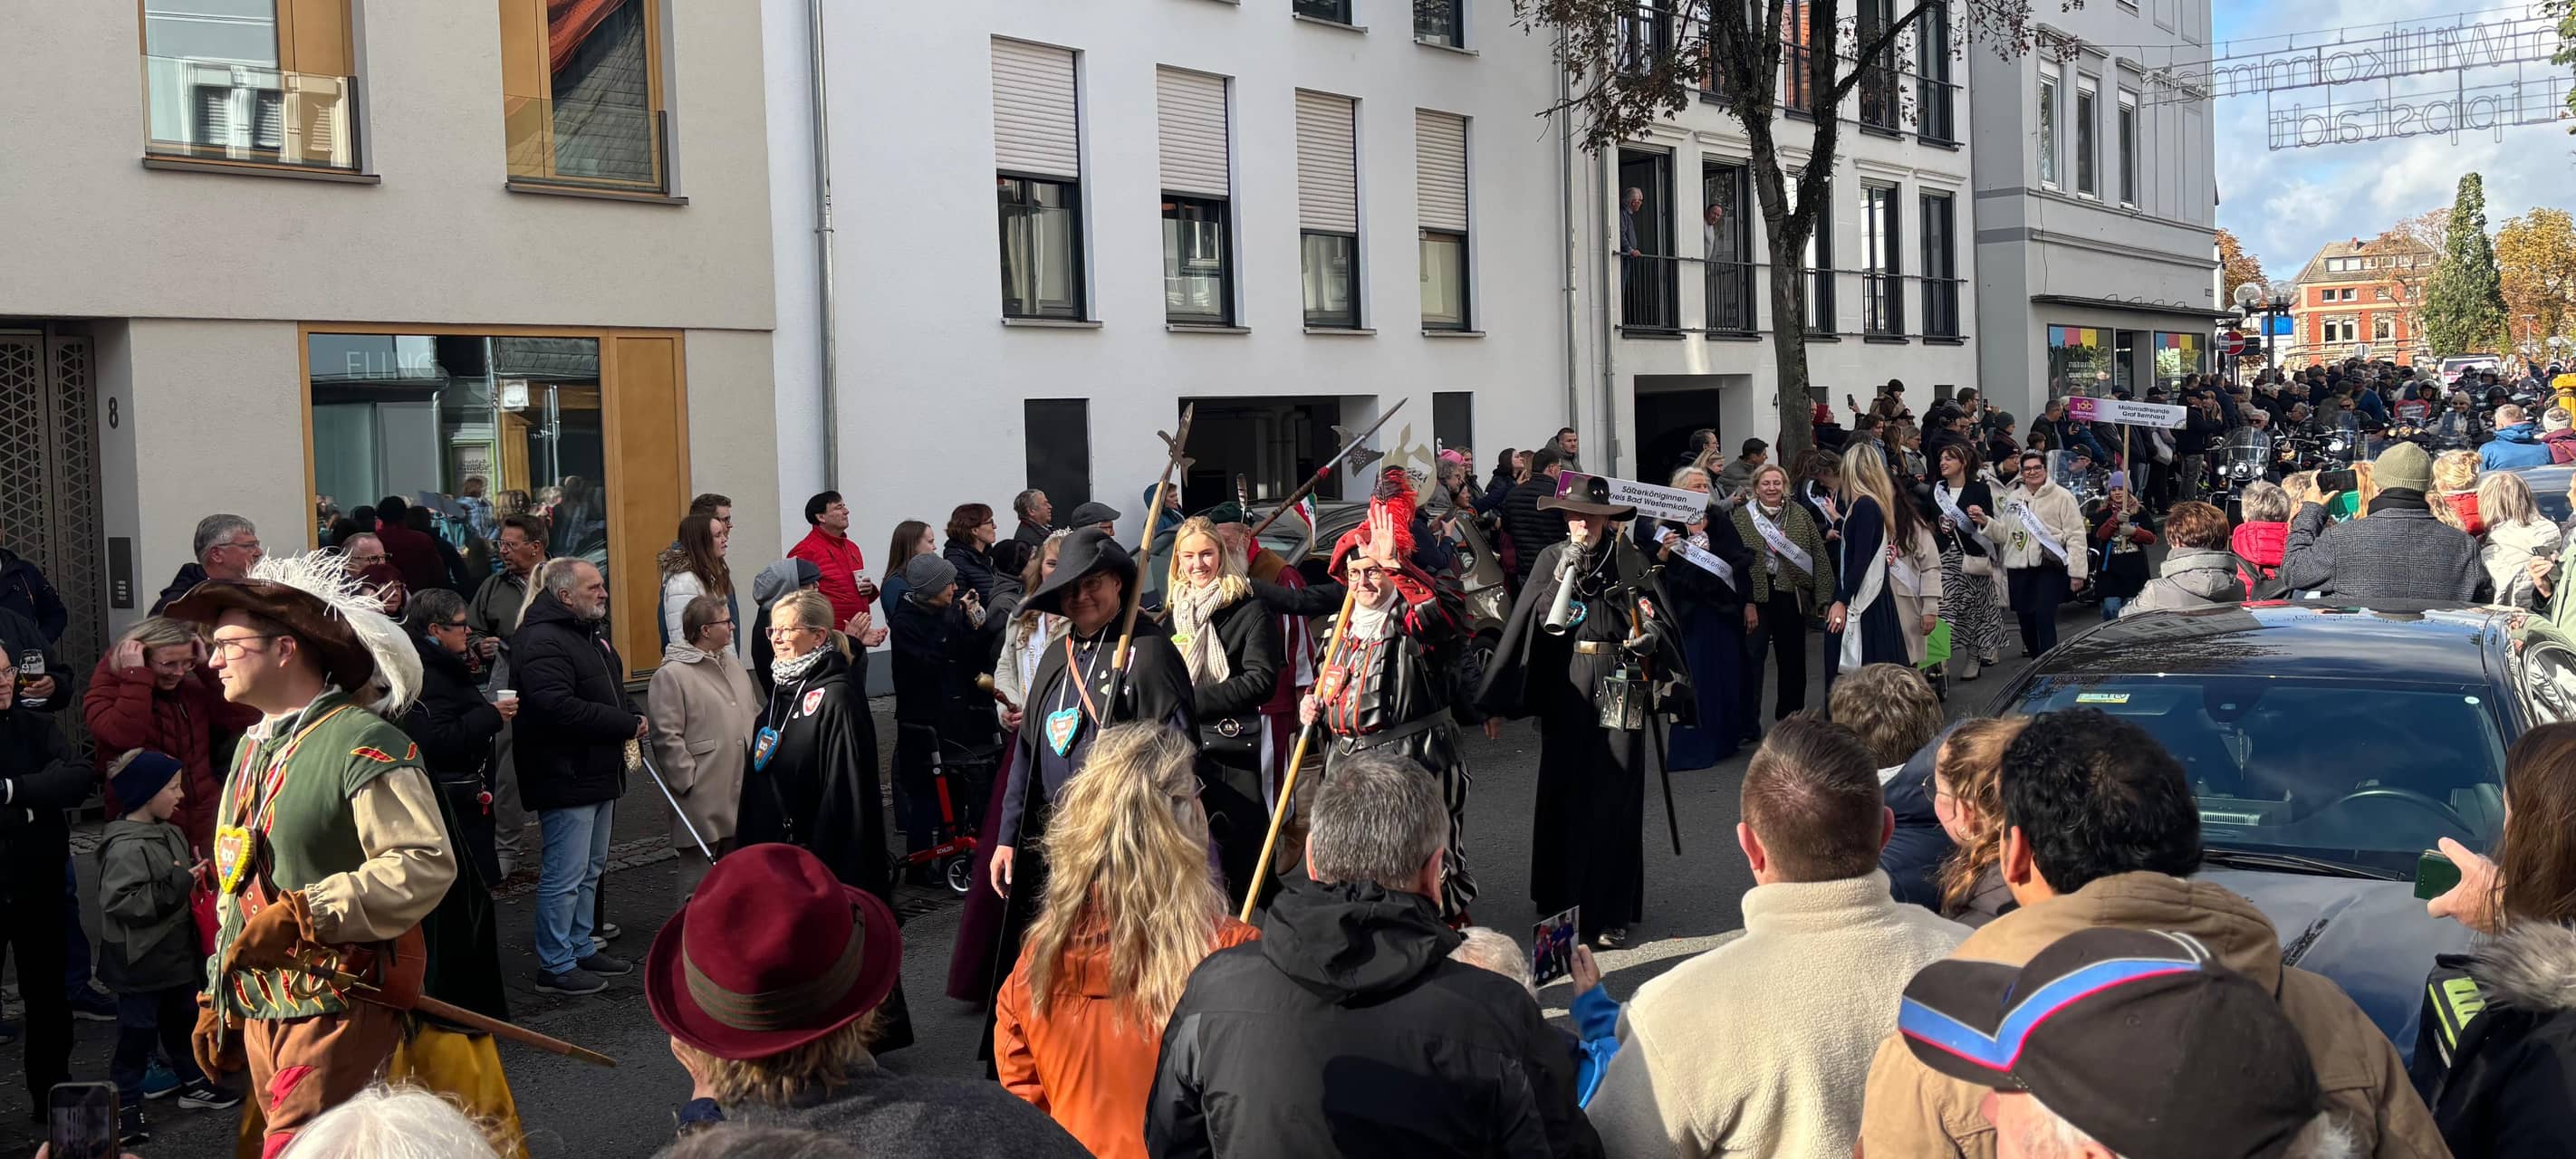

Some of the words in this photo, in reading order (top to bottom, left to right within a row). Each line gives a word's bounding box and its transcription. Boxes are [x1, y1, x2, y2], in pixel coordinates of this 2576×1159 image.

[1773, 393, 1778, 410] 4
[2118, 405, 2170, 415] Motorradfreunde
[109, 397, 119, 429] 8
[1437, 437, 1443, 455] 6
[1621, 485, 1687, 503] Sälzerköniginnen
[1627, 495, 1642, 504] Bad
